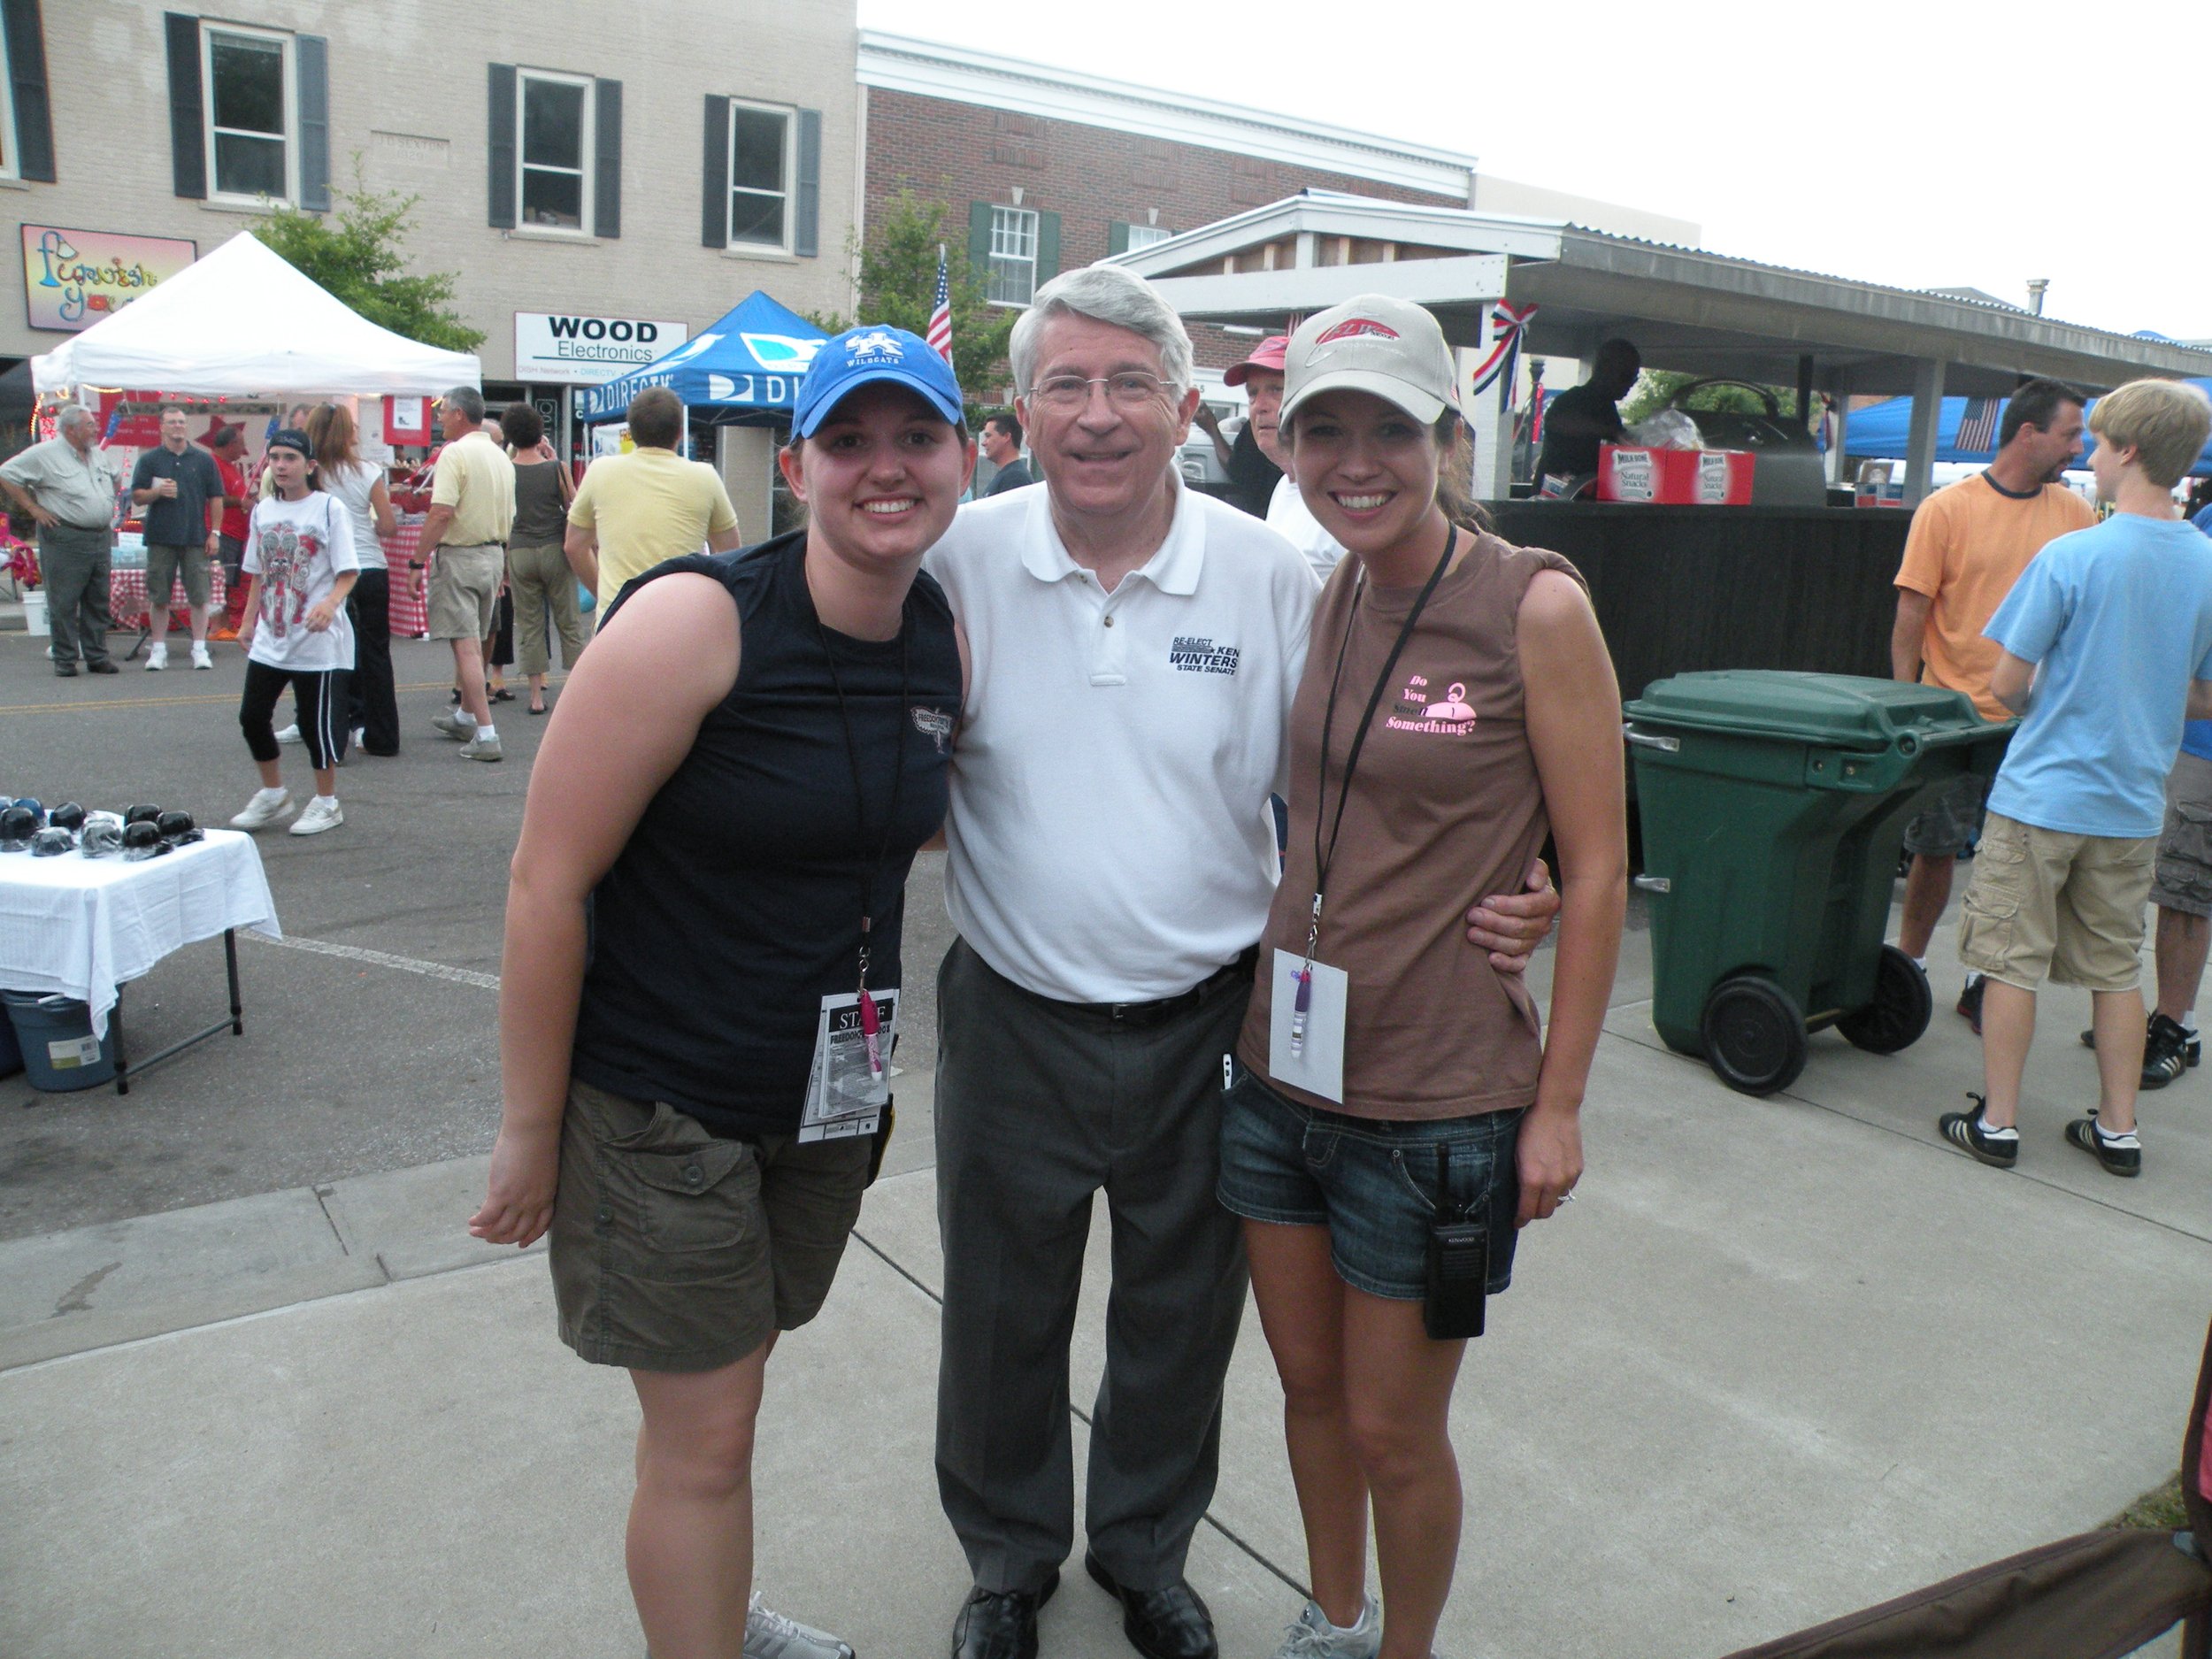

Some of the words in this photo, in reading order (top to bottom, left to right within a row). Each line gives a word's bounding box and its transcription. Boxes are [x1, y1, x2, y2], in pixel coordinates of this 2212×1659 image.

[548, 316, 658, 342] WOOD
[557, 341, 653, 362] Electronics
[847, 356, 899, 368] WILDCATS
[540, 366, 570, 375] Network
[580, 368, 617, 377] DIRECTV
[1620, 472, 1649, 482] Natural
[1621, 480, 1647, 488] Snacks
[1173, 637, 1213, 646] RE-ELECT
[1217, 646, 1240, 657] KEN
[1170, 652, 1239, 669] WINTERS
[1204, 665, 1236, 676] SENATE
[1409, 675, 1428, 687] Do
[1402, 688, 1427, 703] You
[1386, 716, 1476, 736] Something?
